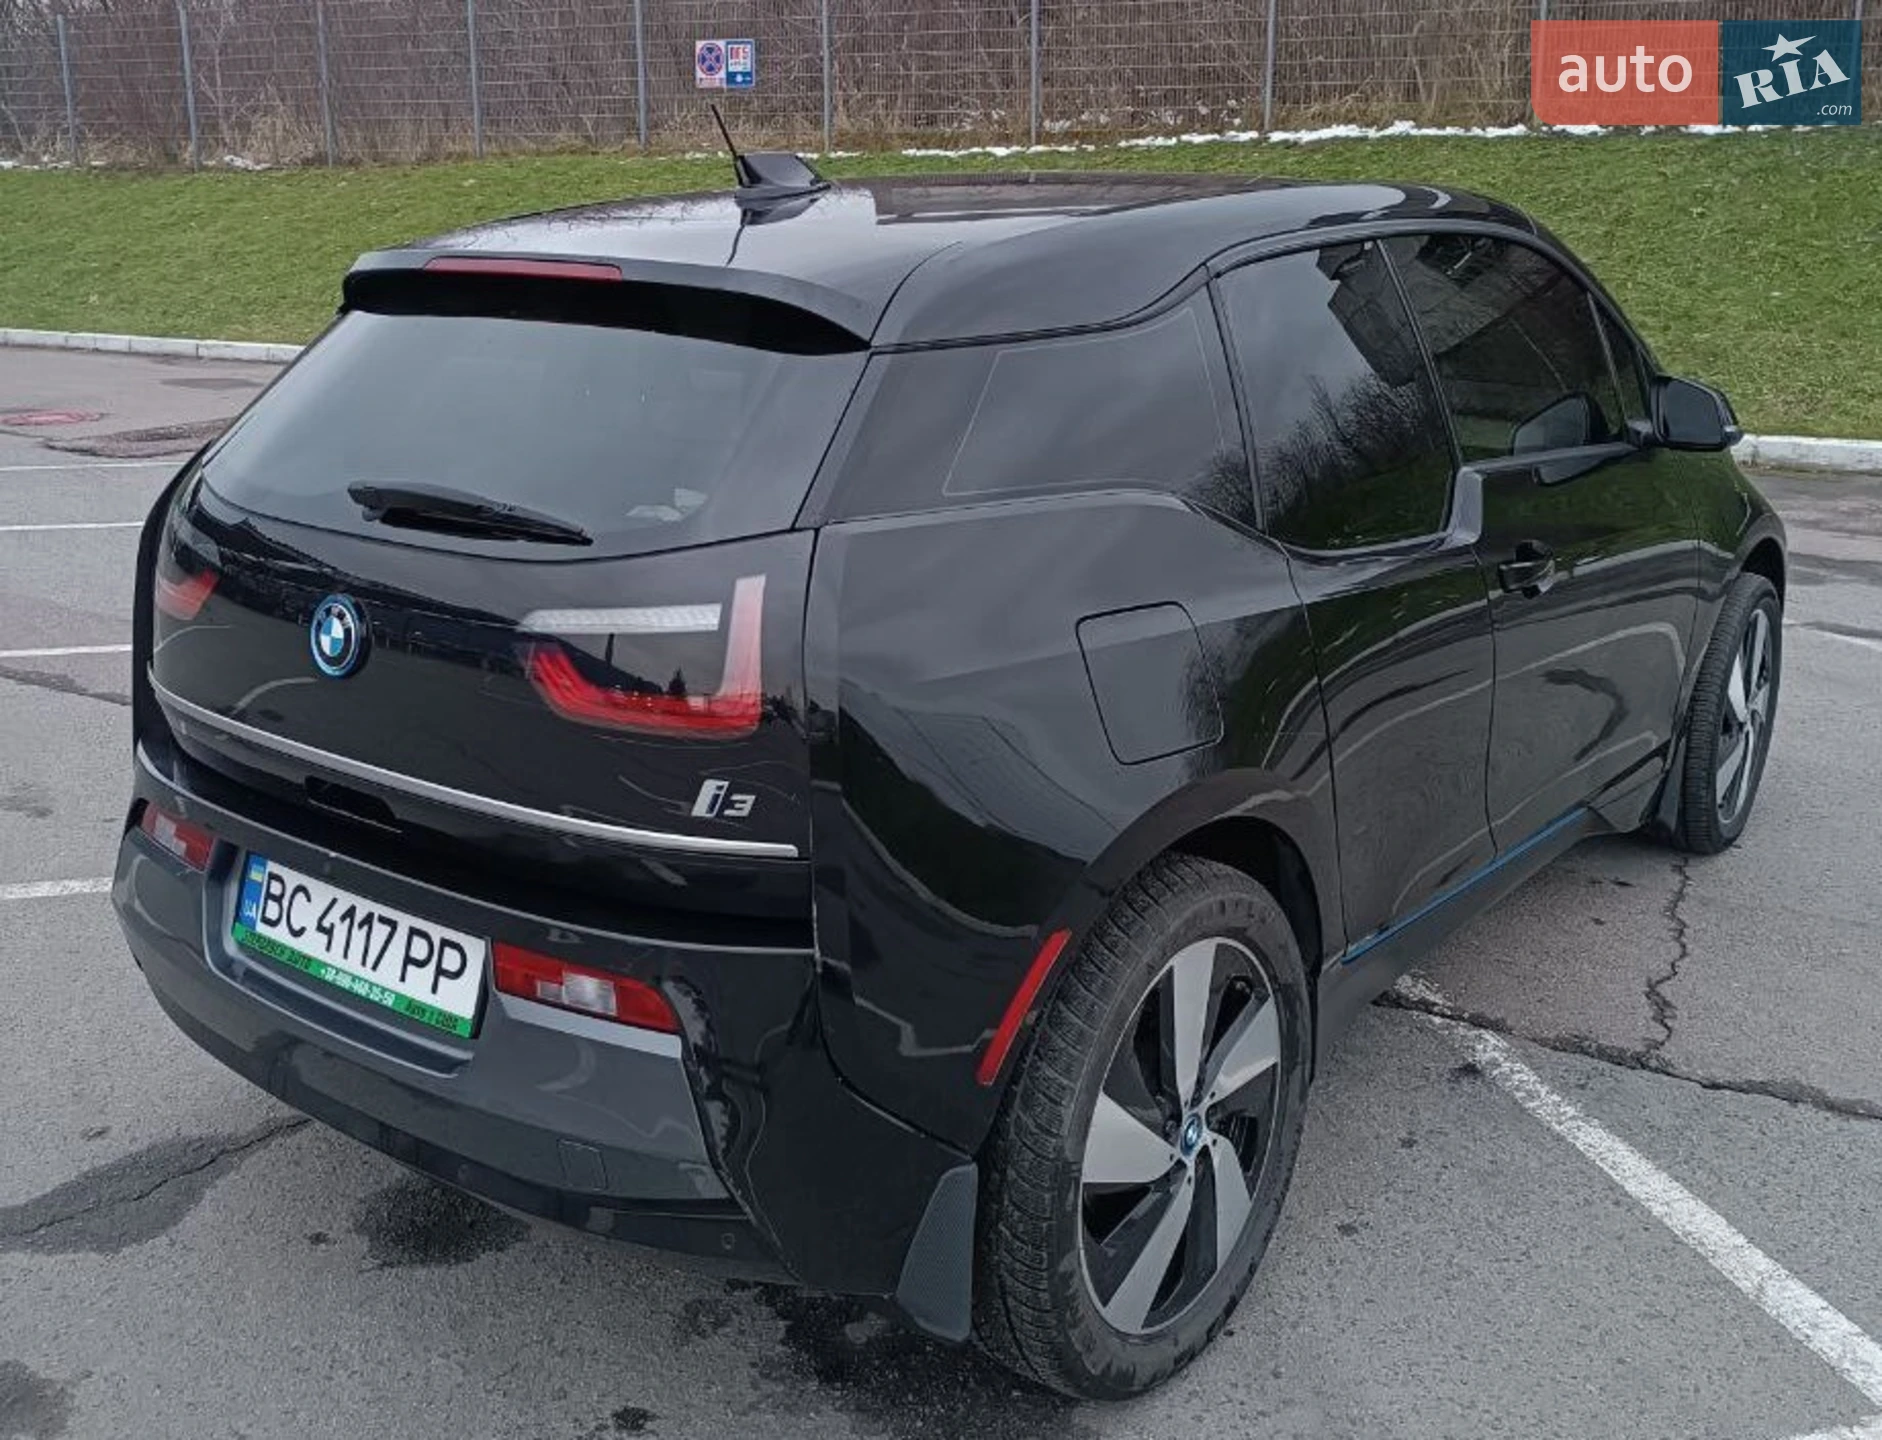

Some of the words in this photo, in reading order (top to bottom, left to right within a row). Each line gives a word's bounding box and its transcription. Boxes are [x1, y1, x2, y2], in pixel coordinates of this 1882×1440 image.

[691, 779, 756, 817] i3
[259, 871, 312, 938] BC
[315, 897, 399, 972] 4117
[399, 926, 468, 995] PP
